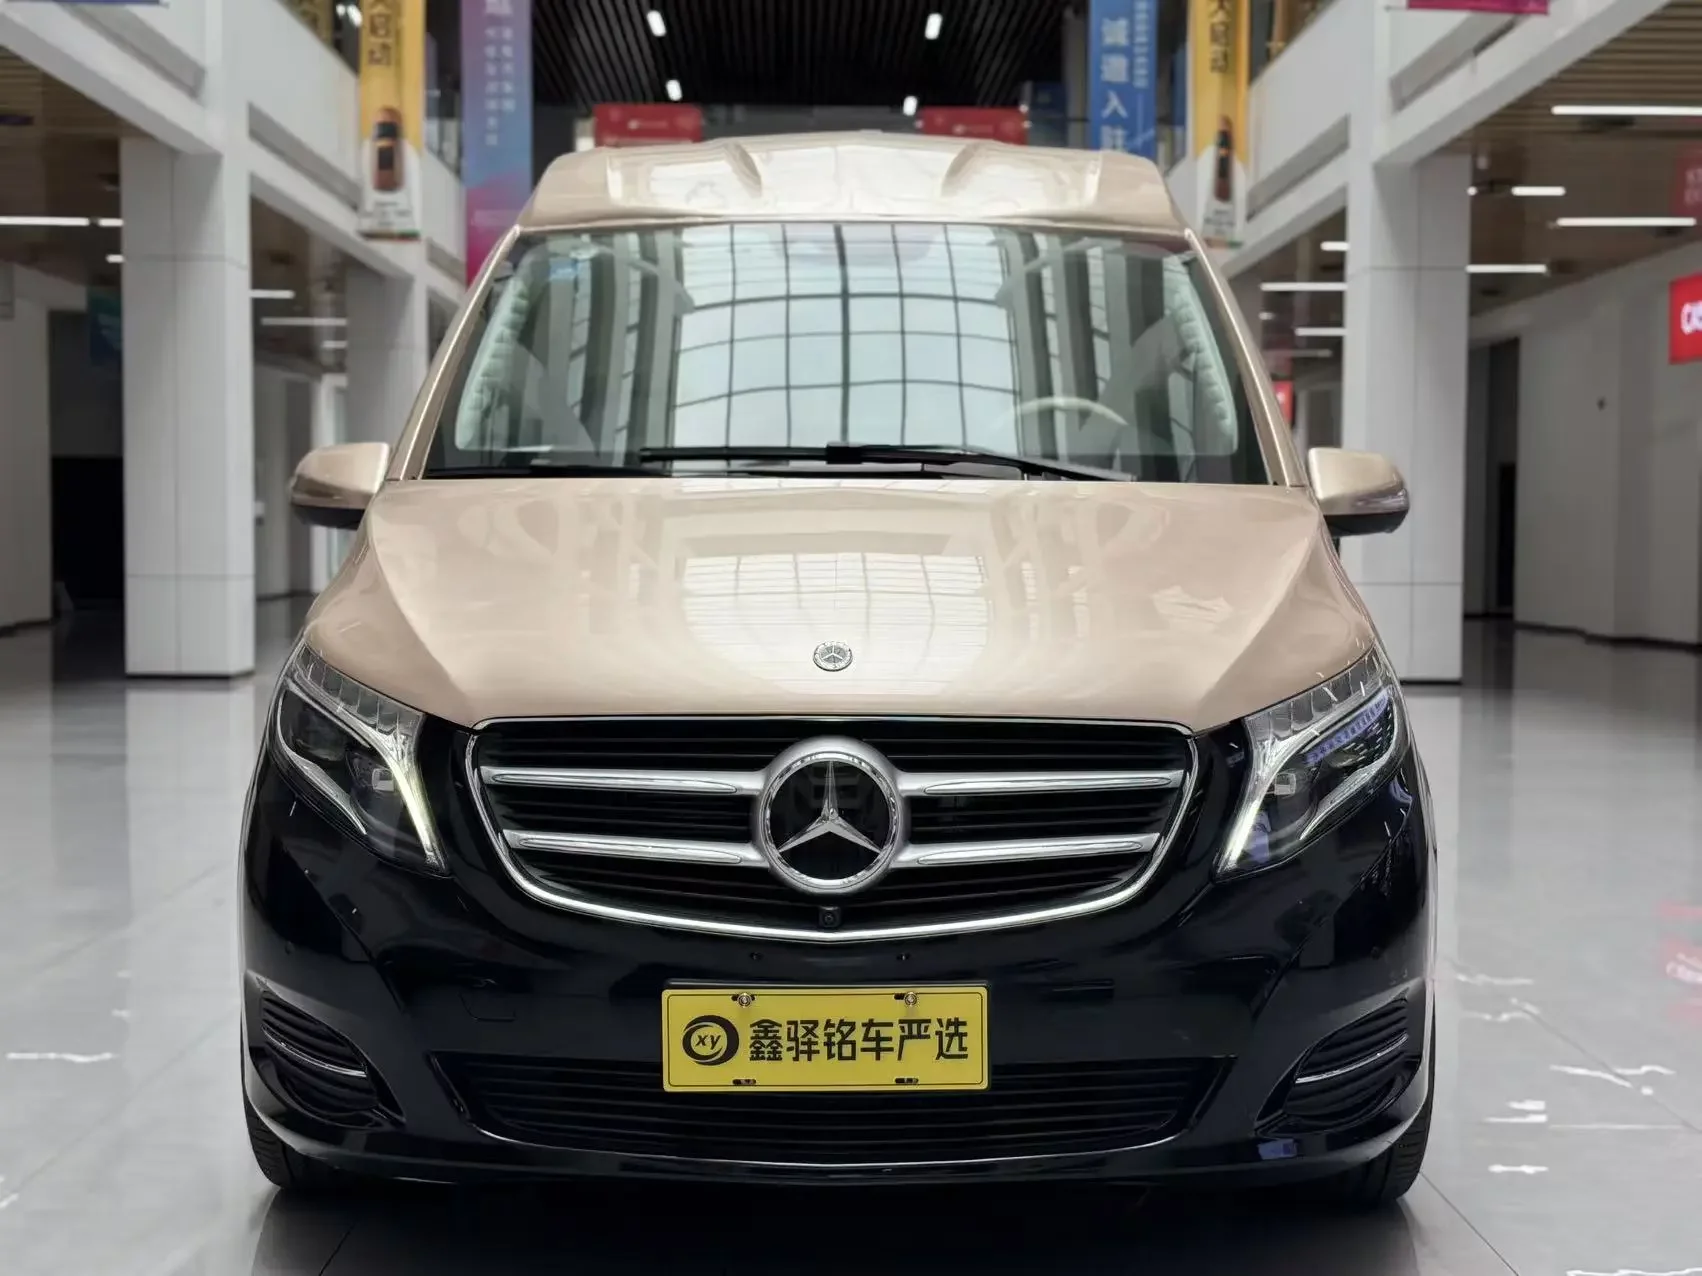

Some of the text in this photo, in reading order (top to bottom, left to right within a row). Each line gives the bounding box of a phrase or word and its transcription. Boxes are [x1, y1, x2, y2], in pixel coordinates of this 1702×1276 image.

[749, 1018, 969, 1061] 鑫驿铭车严选
